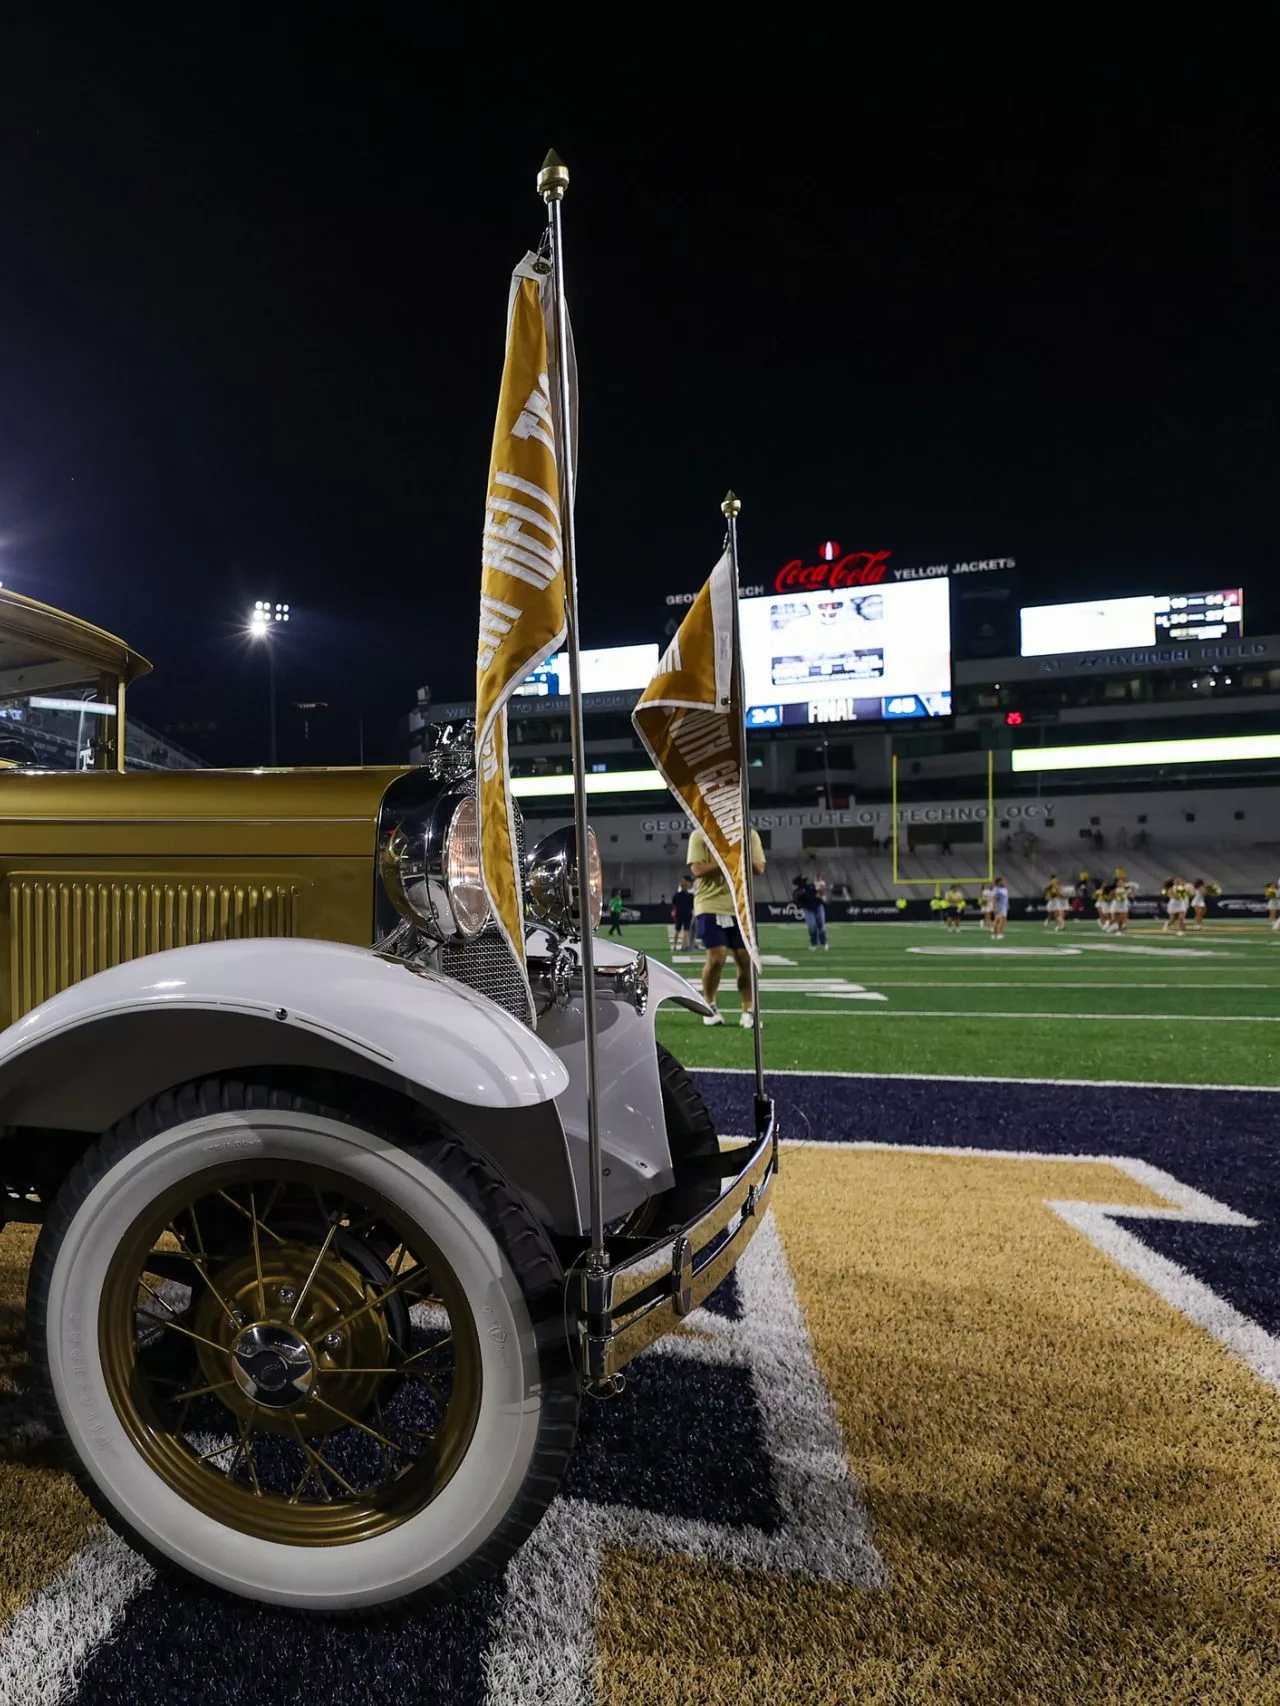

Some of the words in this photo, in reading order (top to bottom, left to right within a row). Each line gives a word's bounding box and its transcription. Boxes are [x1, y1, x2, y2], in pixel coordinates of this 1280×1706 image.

[894, 563, 949, 580] YELLOW
[951, 556, 1016, 575] JACKETS
[808, 698, 858, 724] FINAL
[888, 697, 917, 715] 45
[694, 759, 743, 847] GEORGIA
[749, 811, 850, 829] NSTITUTE
[857, 811, 885, 825] OF
[897, 803, 1056, 823] TECHNOLOGY
